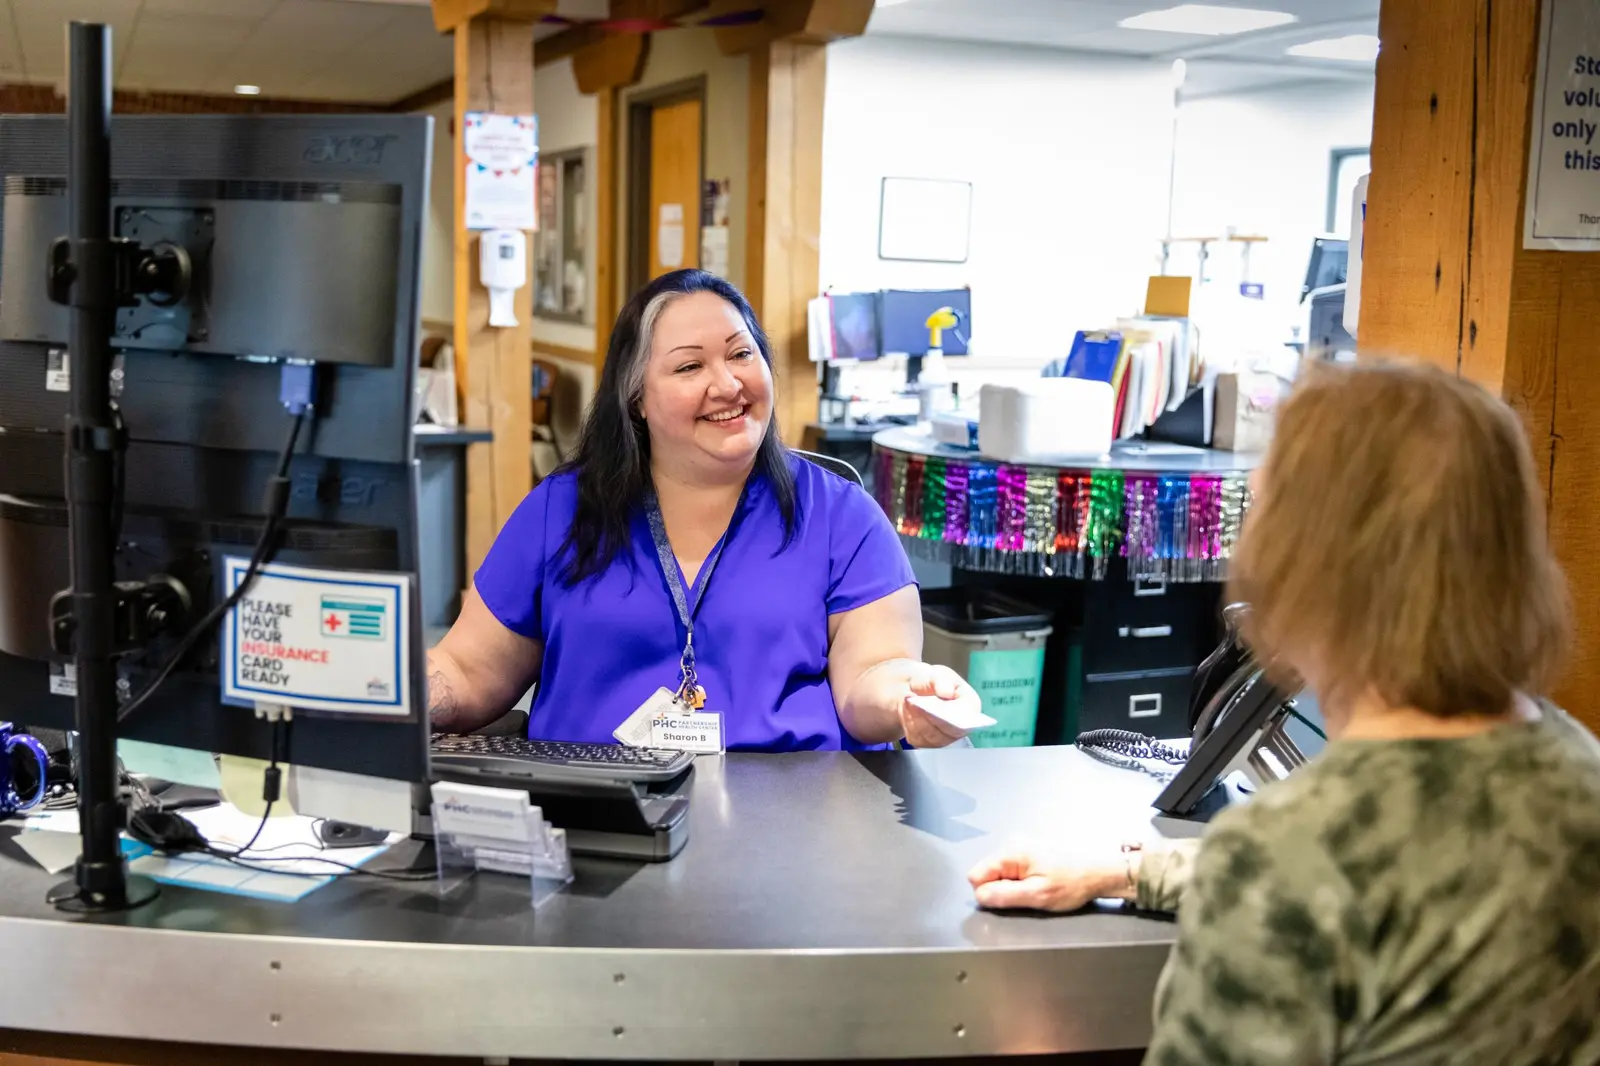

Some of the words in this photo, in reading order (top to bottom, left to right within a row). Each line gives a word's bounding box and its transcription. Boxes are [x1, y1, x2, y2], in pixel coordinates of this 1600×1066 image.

[1552, 119, 1597, 145] only
[303, 134, 399, 164] acer
[1564, 150, 1600, 171] this
[295, 474, 387, 505] aer
[242, 598, 292, 617] PLEASE
[242, 613, 280, 630] HAVE
[242, 628, 282, 643] YOUR
[241, 641, 330, 664] INSURANCE
[241, 655, 283, 671] CARD
[242, 669, 290, 686] READY
[653, 720, 677, 728] PHC
[663, 733, 697, 741] Sharon
